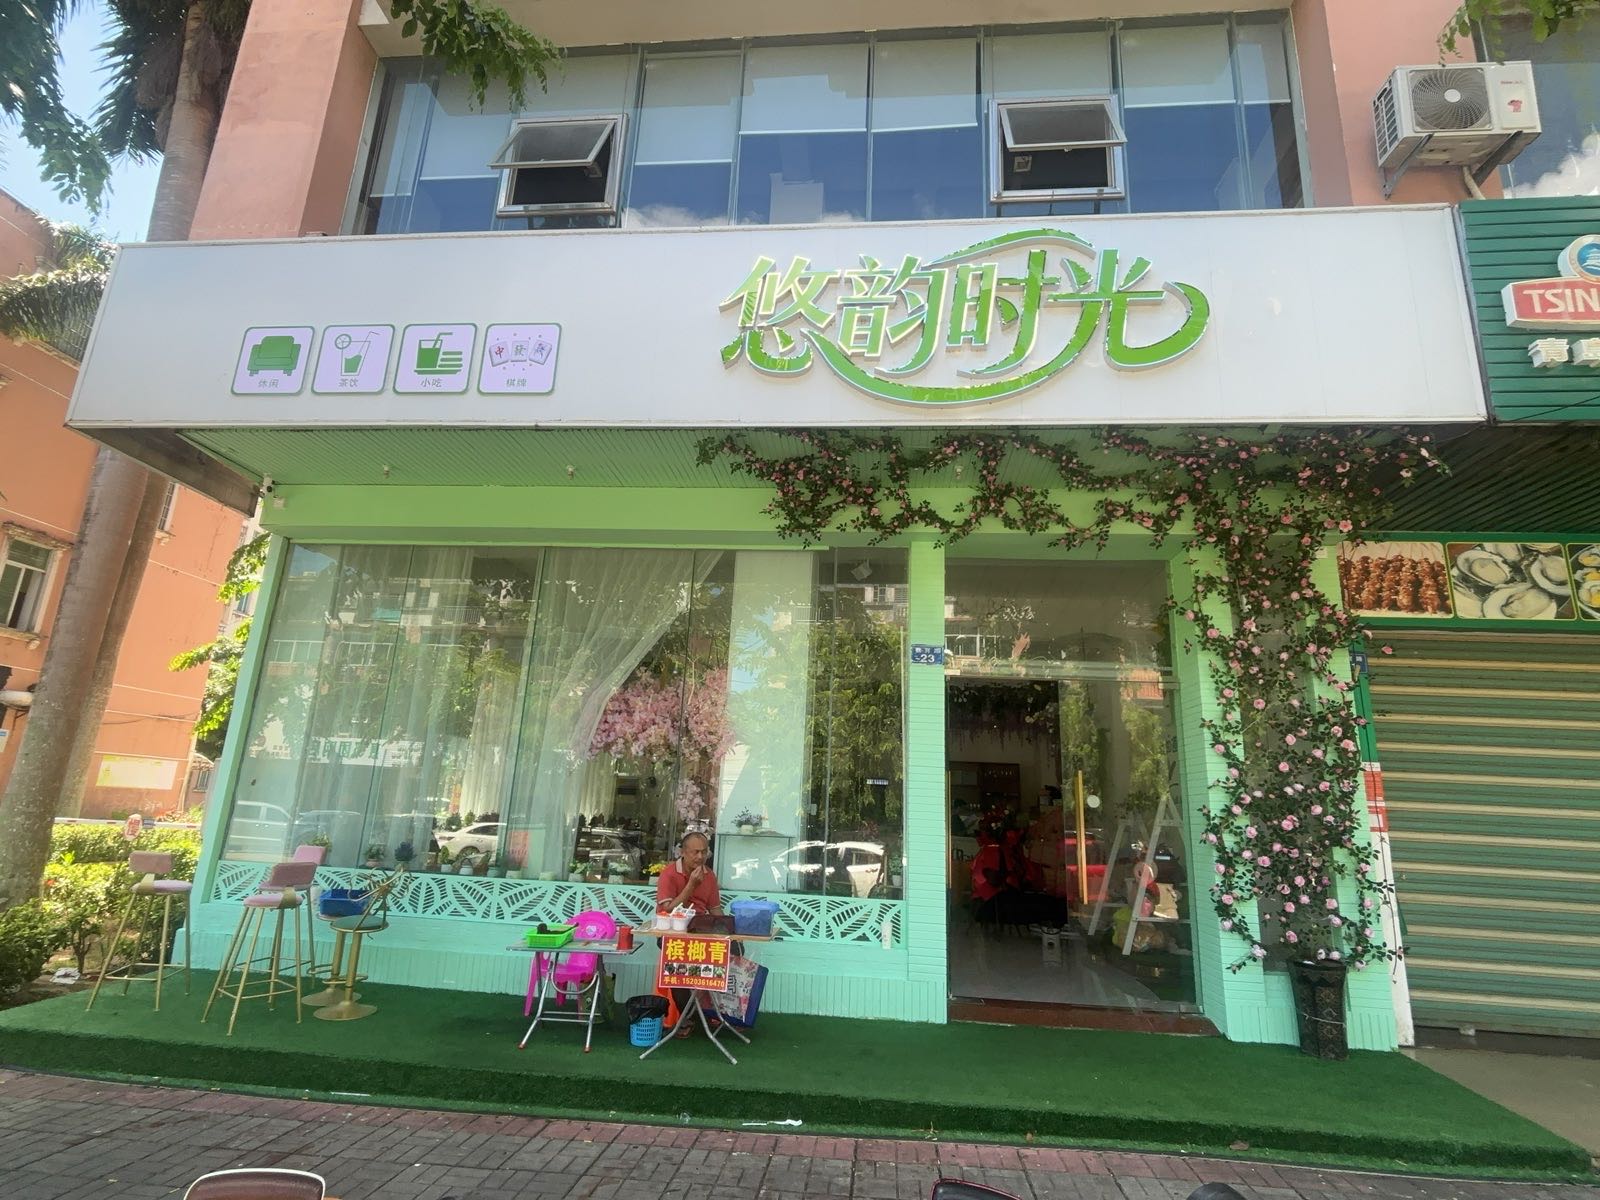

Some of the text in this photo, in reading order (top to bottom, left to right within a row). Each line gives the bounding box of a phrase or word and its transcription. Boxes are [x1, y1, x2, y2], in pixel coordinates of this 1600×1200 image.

[719, 228, 1210, 408] 悠韵时光
[257, 378, 280, 389] 休闲
[338, 378, 359, 388] 茶饮
[420, 377, 443, 388] 小吃
[506, 378, 528, 388] 棋牌
[666, 939, 727, 964] 槟榔青
